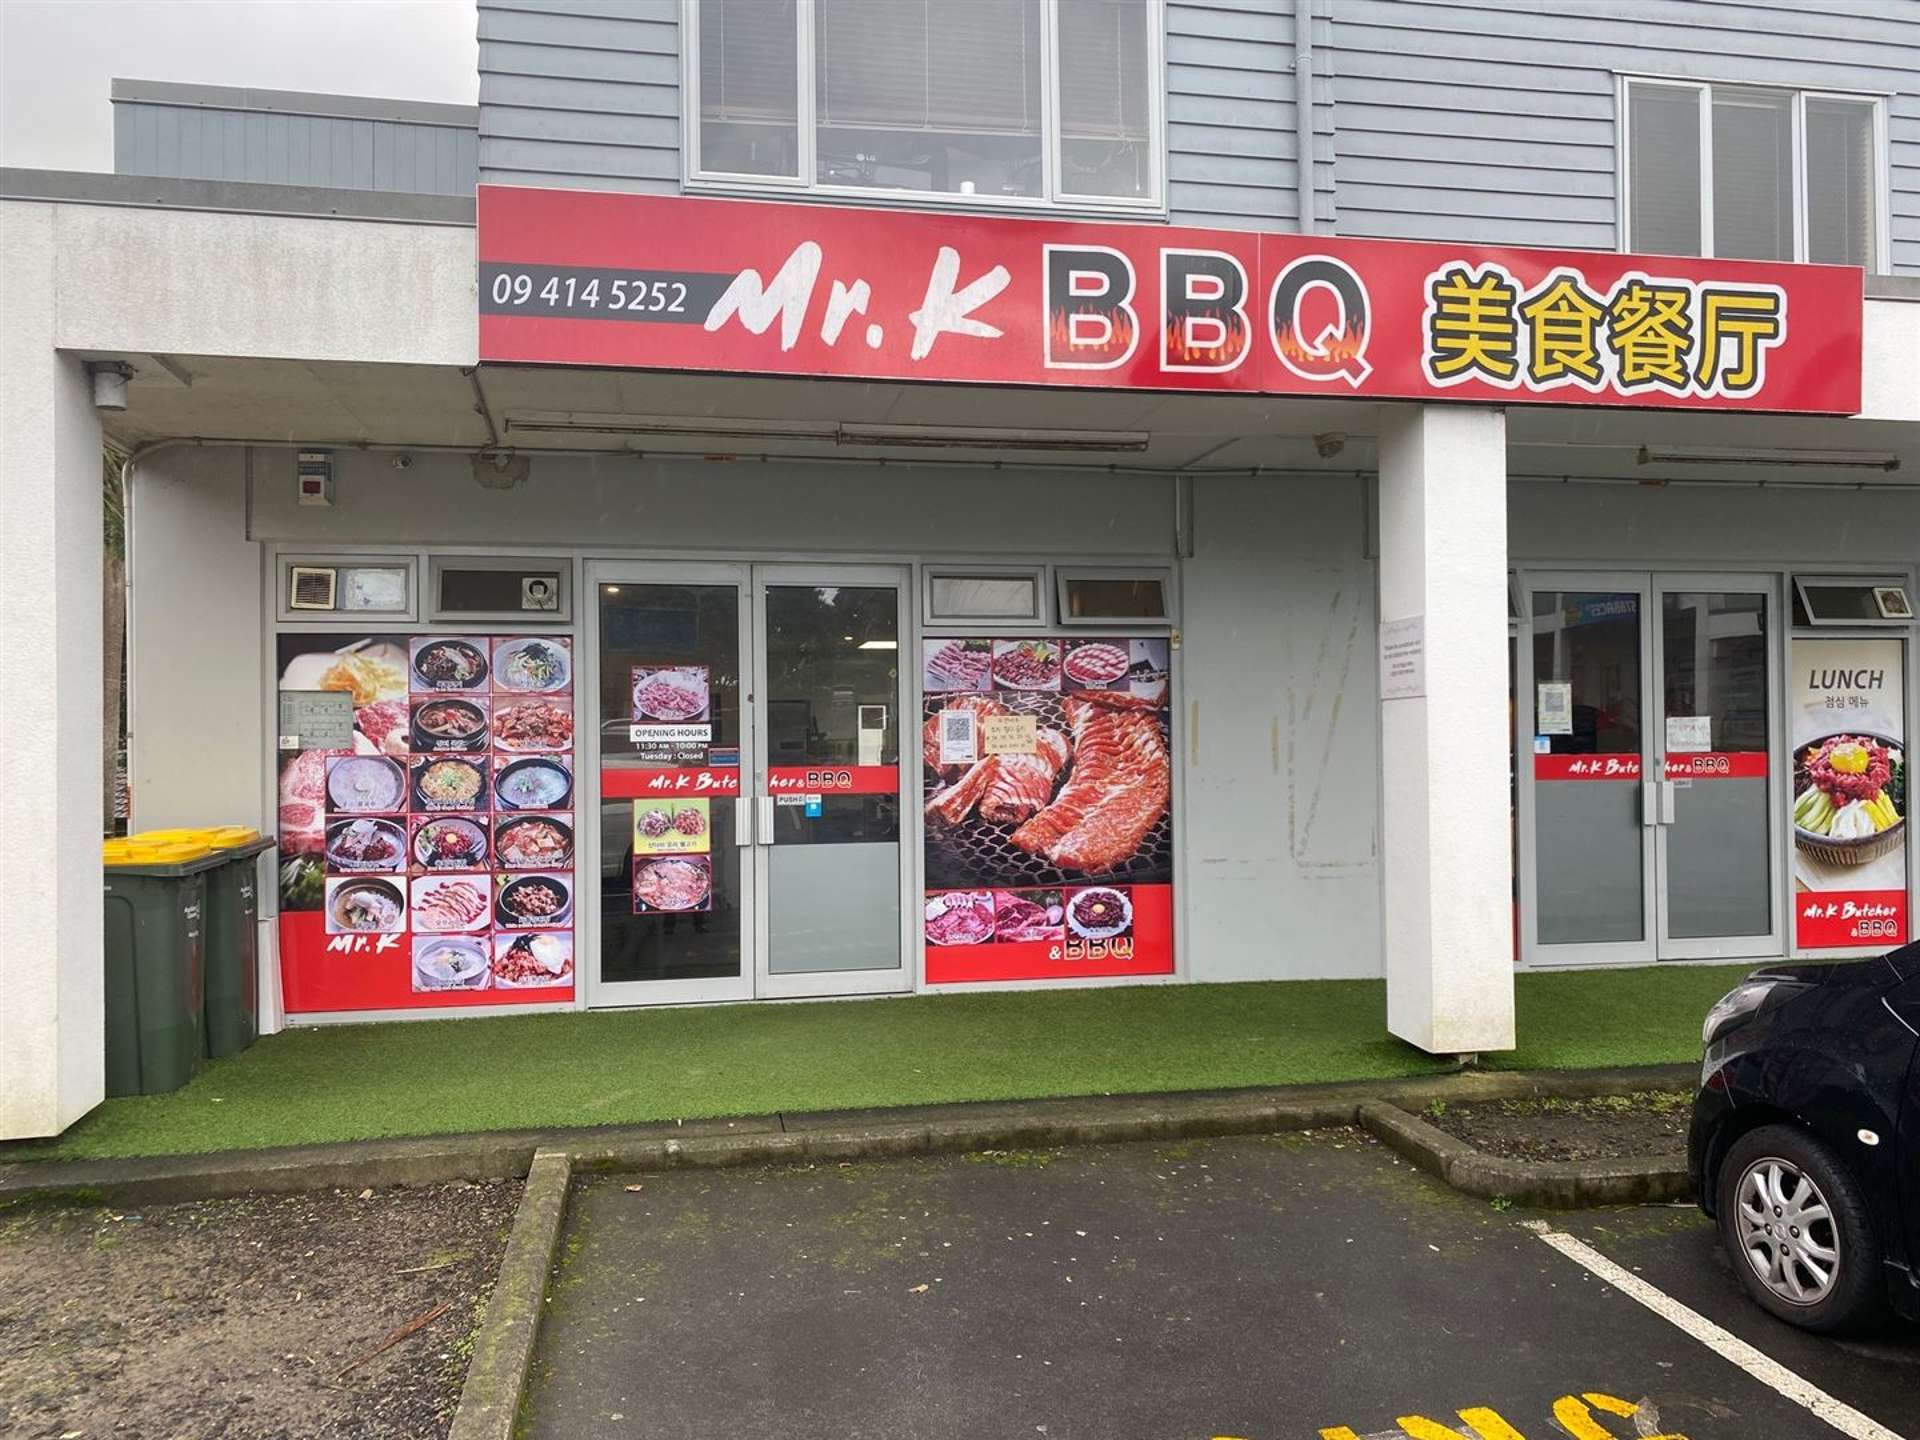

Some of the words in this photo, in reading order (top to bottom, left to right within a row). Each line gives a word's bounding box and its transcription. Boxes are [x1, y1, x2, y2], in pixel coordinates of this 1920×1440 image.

[491, 273, 532, 305] 09
[540, 277, 600, 309] 414
[608, 279, 687, 313] 5252
[704, 240, 883, 352] Mr.
[908, 246, 1012, 360] K
[1042, 243, 1373, 389] BBQ
[1424, 262, 1784, 397] 美食餐厅
[1808, 669, 1885, 690] LUNCH
[1825, 695, 1845, 708] 점심
[1848, 695, 1869, 708] 메뉴
[635, 729, 675, 737] OPENING
[676, 728, 708, 737] HOURS
[676, 742, 697, 750] 10:00
[640, 752, 672, 761] Tuesday
[678, 751, 703, 760] Closed
[1692, 757, 1730, 774] BBQ
[806, 770, 852, 789] BBQ
[1840, 901, 1897, 919] Butcher
[1859, 919, 1898, 937] BBQ
[1049, 945, 1061, 960] &
[1064, 937, 1134, 960] BBQ
